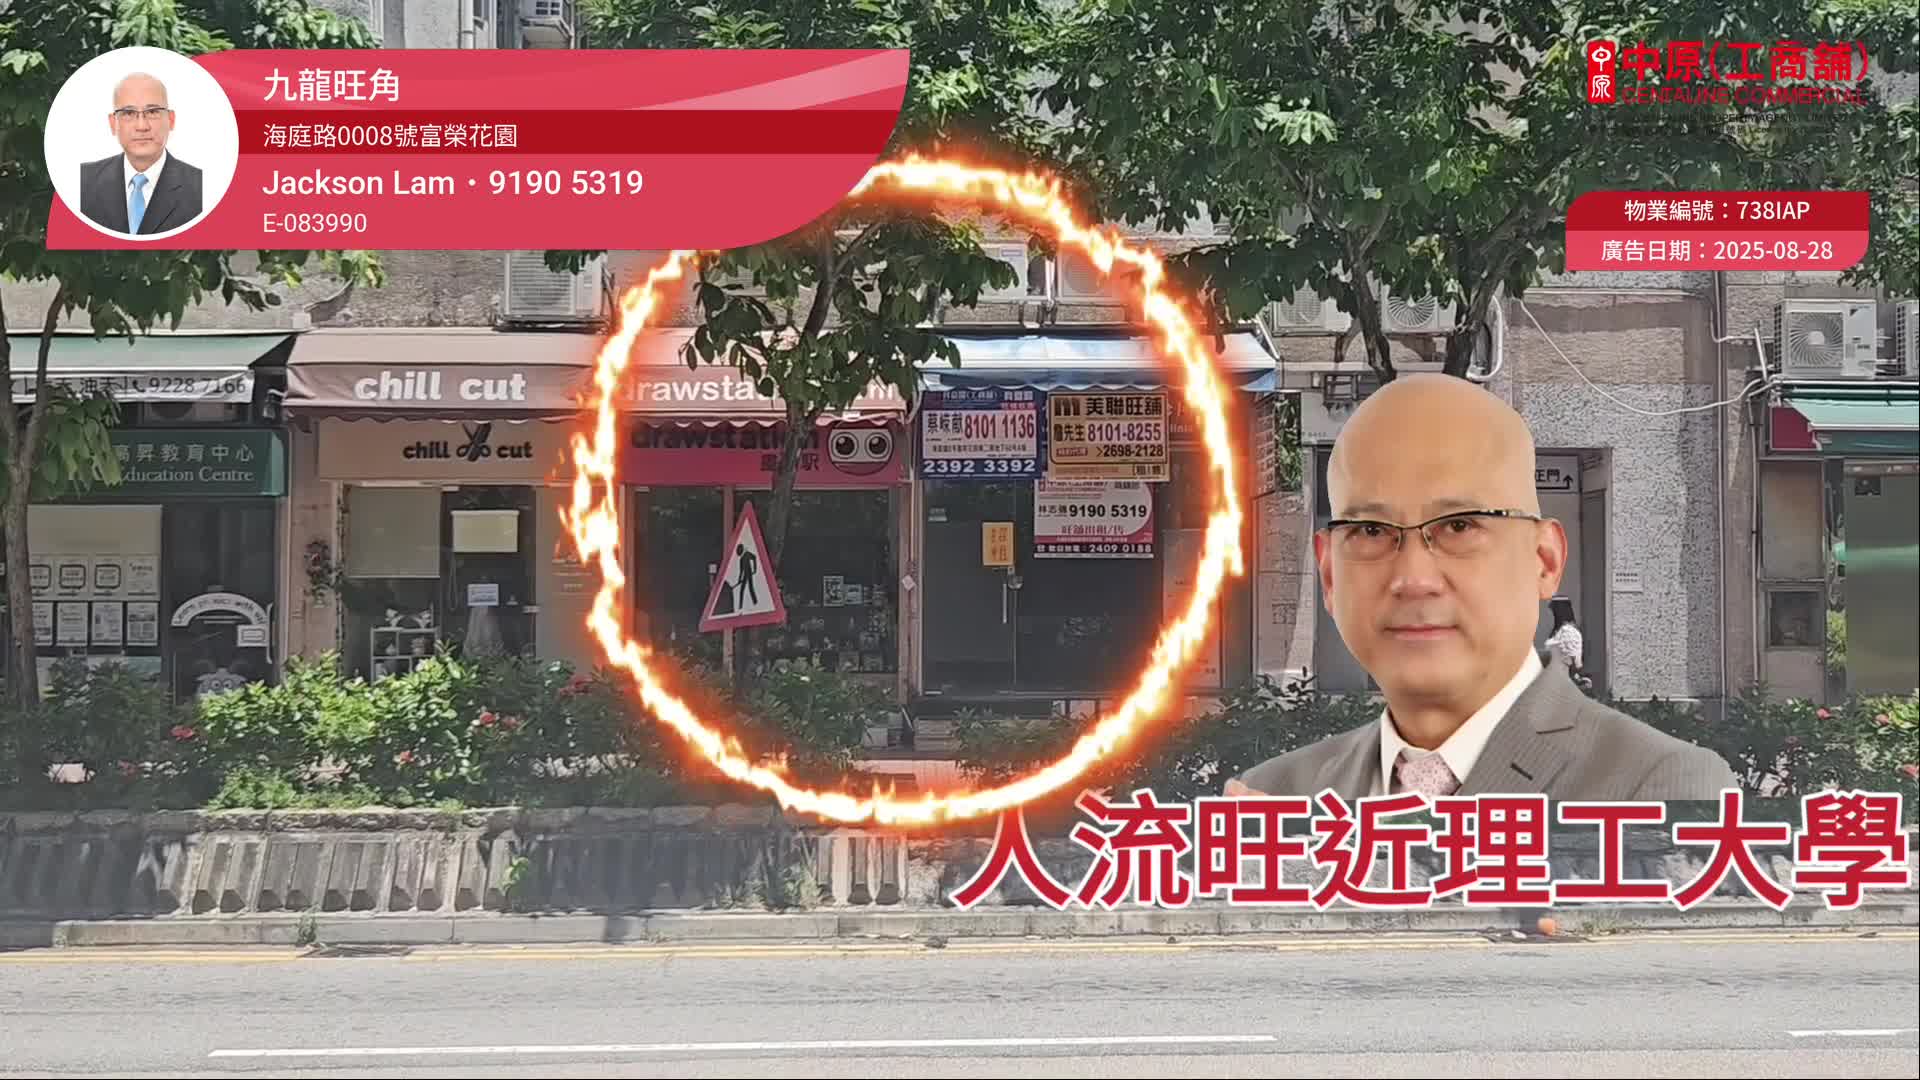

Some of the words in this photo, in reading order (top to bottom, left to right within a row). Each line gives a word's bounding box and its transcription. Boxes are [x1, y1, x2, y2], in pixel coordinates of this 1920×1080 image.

[150, 376, 195, 393] 9228
[354, 371, 441, 401] chill
[459, 373, 526, 401] cut
[1086, 397, 1162, 416] 美聯旺舖
[964, 414, 997, 439] 8101
[1002, 414, 1034, 439] 1136
[1087, 423, 1161, 442] 8101-8255
[402, 441, 451, 459] chill
[496, 441, 533, 459] cut
[199, 467, 253, 482] Centre
[923, 460, 975, 473] 2392
[983, 459, 1036, 473] 3392
[1069, 504, 1106, 518] 9190
[1110, 504, 1147, 518] 5319
[1089, 544, 1119, 553] 2409
